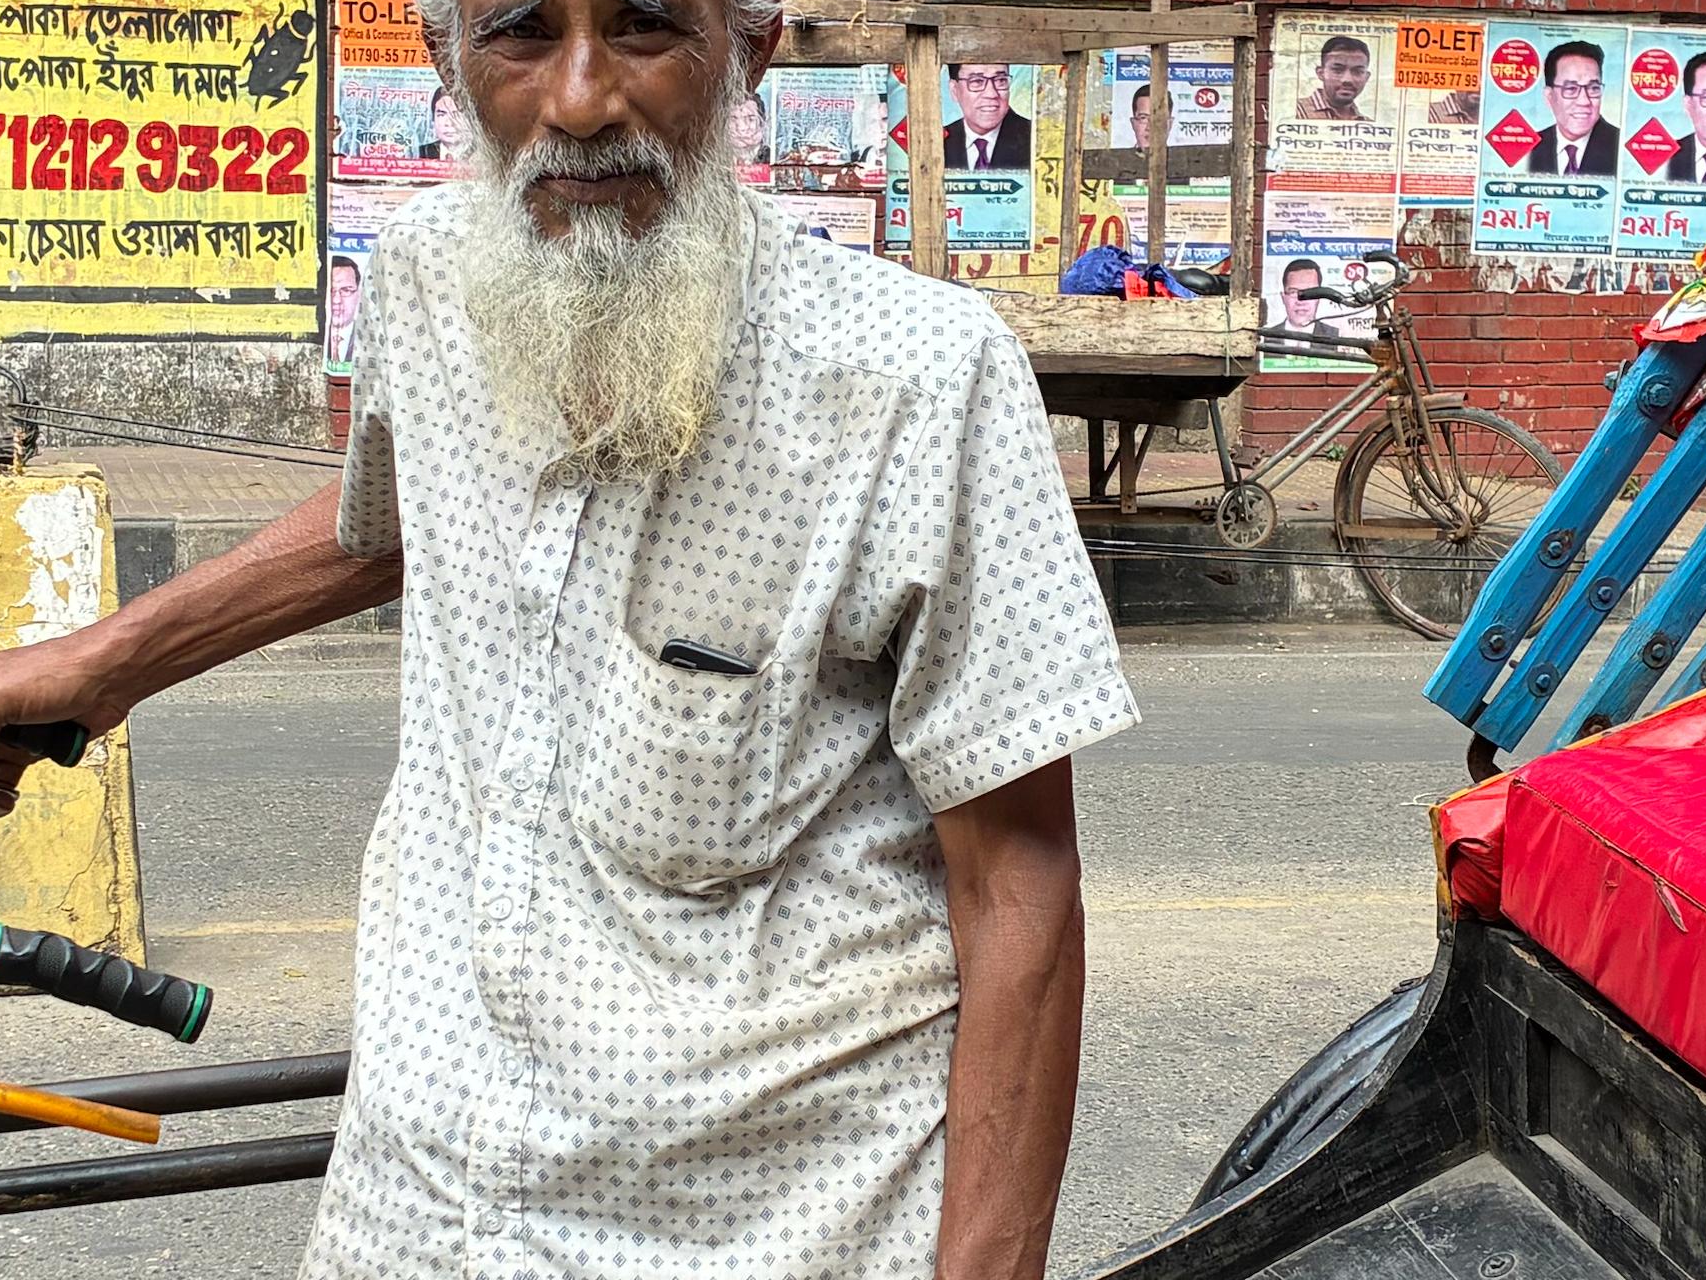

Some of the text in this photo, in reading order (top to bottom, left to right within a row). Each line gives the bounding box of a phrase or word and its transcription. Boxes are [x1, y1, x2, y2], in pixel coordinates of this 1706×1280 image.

[343, 1, 419, 25] TO-LE
[1401, 27, 1481, 52] TO-LET
[343, 47, 431, 64] 01790-55 77 9
[1398, 70, 1478, 87] 01790-55 77 99
[1198, 92, 1216, 105] ১৭
[1276, 122, 1396, 138] মোঃ শামিম
[1481, 203, 1551, 231] এম.পি
[1621, 211, 1689, 238] এম.পি
[1347, 267, 1365, 279] ১৭
